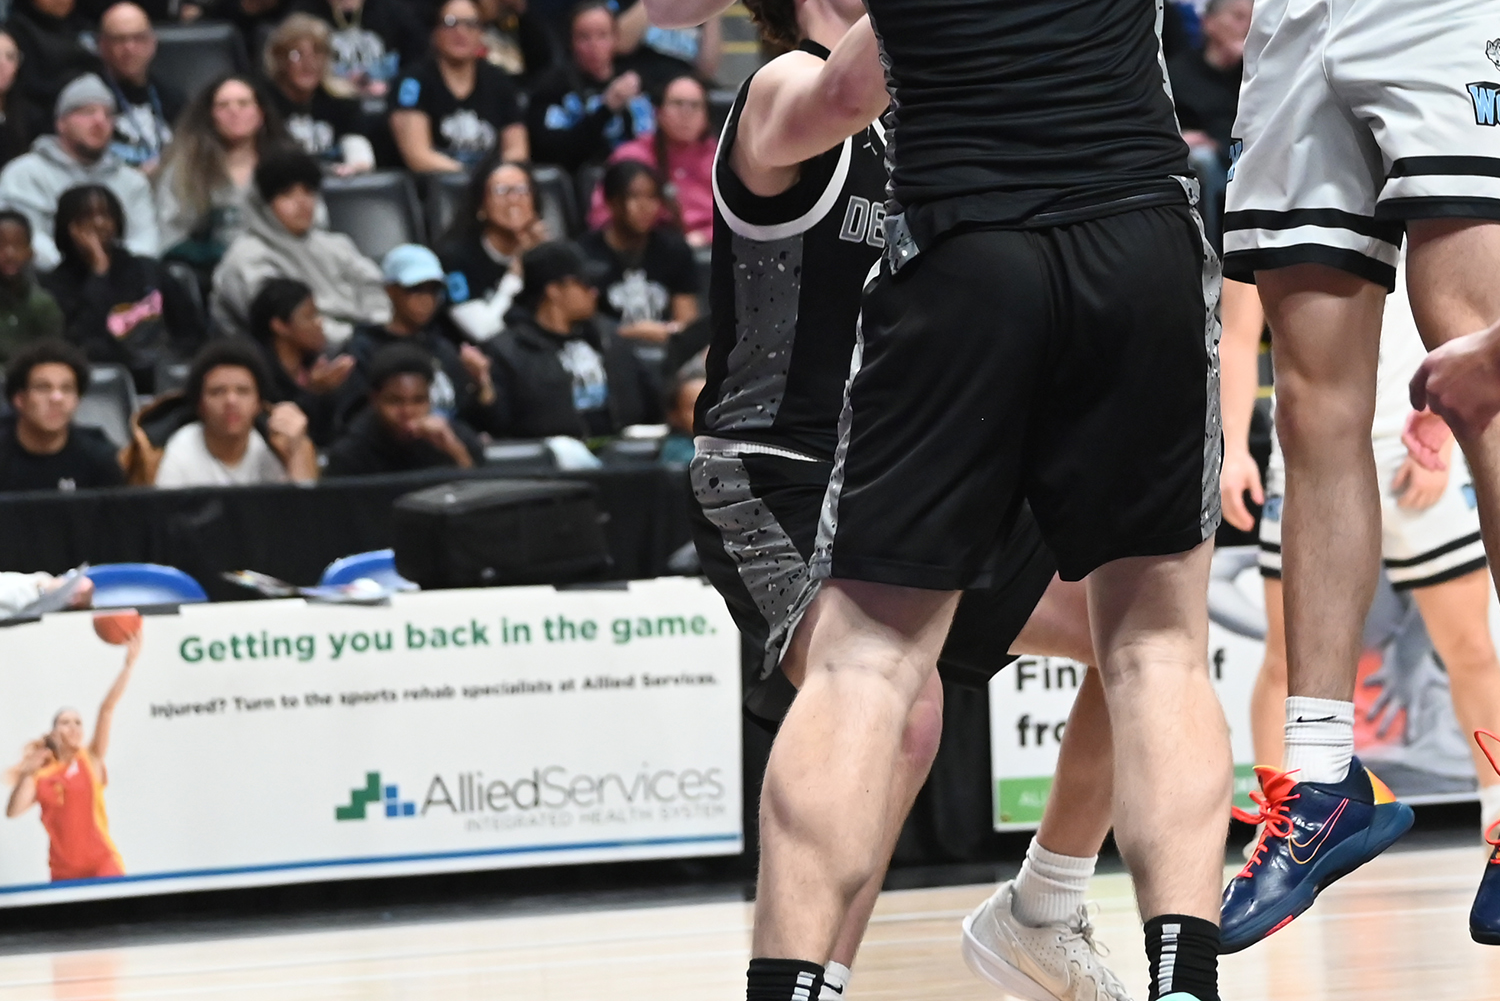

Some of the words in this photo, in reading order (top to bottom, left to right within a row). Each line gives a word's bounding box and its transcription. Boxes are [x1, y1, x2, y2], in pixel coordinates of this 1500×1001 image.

[180, 630, 316, 662] Getting
[329, 630, 393, 660] you
[406, 619, 489, 649] back
[502, 616, 532, 643] in
[545, 613, 598, 641] the
[612, 613, 717, 645] game.
[1015, 659, 1078, 692] Fin
[150, 698, 227, 719] Injured?
[234, 696, 276, 713] Turn
[281, 694, 299, 710] to
[305, 691, 332, 707] the
[340, 688, 397, 707] sports
[403, 683, 455, 700] rehab
[462, 679, 553, 699] specialists
[560, 679, 576, 692] at
[582, 674, 635, 691] Allied
[643, 671, 718, 687] Services.
[1017, 713, 1067, 747] fro
[465, 812, 574, 832] INTEGRATED
[580, 807, 653, 826] HEALTH
[659, 803, 726, 822] SYSTEM
